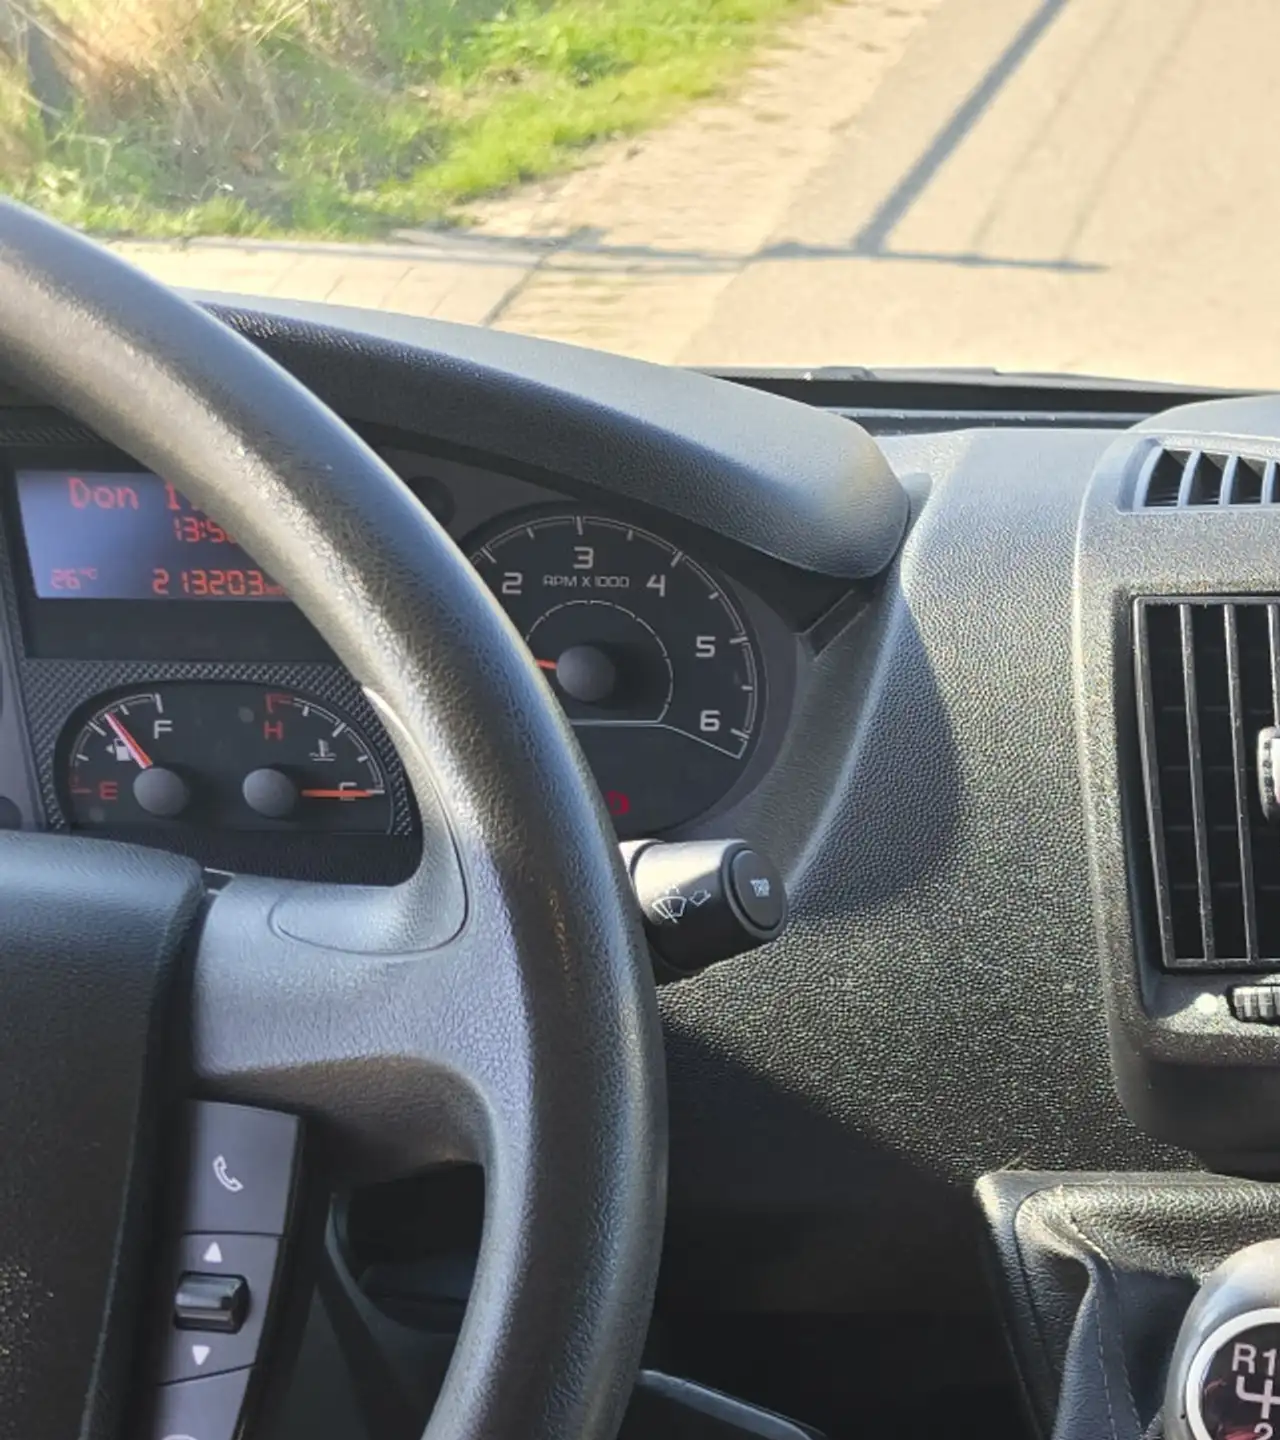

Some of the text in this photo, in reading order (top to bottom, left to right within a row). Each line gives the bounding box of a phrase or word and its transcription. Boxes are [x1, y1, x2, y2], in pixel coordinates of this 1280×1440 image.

[67, 476, 139, 510] Don
[173, 516, 237, 544] 13:5
[573, 546, 594, 569] 3
[502, 572, 522, 594] 2
[543, 575, 577, 588] RPM
[595, 576, 630, 588] 1000
[646, 574, 666, 597] 4
[695, 636, 716, 658] 5
[154, 720, 173, 739] F
[264, 721, 283, 740] H
[700, 710, 721, 731] 6
[100, 781, 118, 800] E
[1232, 1343, 1257, 1374] R
[1262, 1348, 1277, 1376] 1
